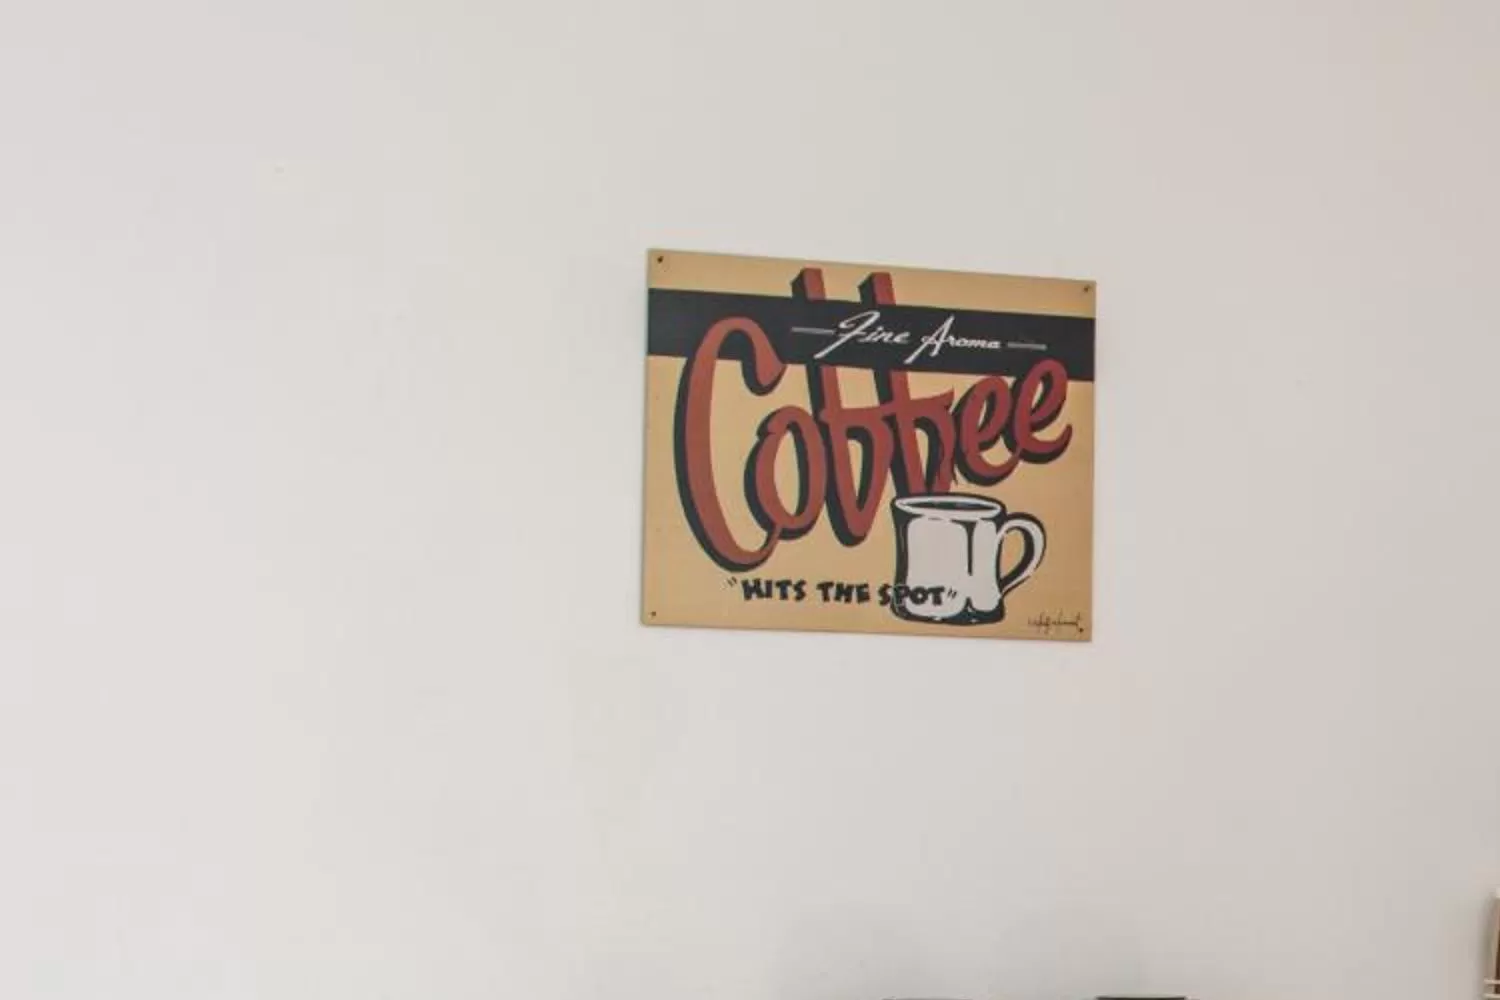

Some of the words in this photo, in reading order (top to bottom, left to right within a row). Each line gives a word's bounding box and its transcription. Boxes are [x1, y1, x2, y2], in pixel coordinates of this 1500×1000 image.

[814, 310, 909, 359] Fine
[904, 313, 1000, 364] Aroma
[674, 267, 1073, 573] Coffee
[815, 581, 870, 604] THE
